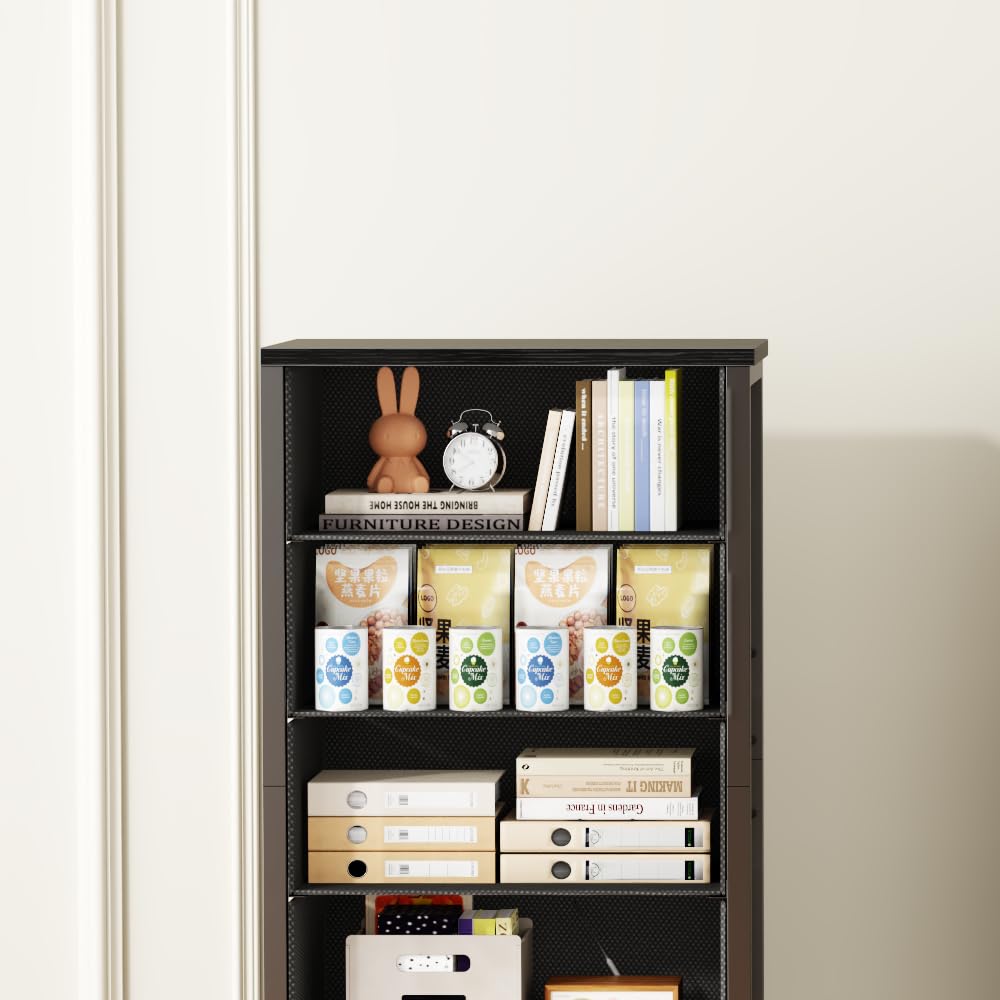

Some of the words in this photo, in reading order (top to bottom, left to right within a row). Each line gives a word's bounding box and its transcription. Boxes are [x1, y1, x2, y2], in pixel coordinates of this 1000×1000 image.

[611, 452, 617, 460] of
[369, 501, 392, 510] HOME
[394, 501, 420, 510] HOUSE
[422, 501, 438, 510] THE
[440, 501, 478, 510] BRINGING
[322, 519, 440, 531] FURNITURE
[447, 519, 521, 531] DESIGN
[326, 666, 352, 674] Cupcake
[394, 666, 420, 674] Cupcake
[461, 666, 486, 674] Cupcake
[528, 666, 554, 674] Cupcake
[596, 666, 621, 674] Cupcake
[663, 666, 688, 674] Cupcake
[333, 674, 348, 682] Mix
[401, 674, 416, 682] Mix
[468, 674, 483, 682] Mix
[535, 674, 550, 682] Mix
[603, 674, 618, 682] Mix
[670, 674, 685, 682] Mix
[626, 780, 638, 792] IT
[640, 780, 683, 792] MAKING
[566, 804, 595, 815] France
[597, 804, 606, 815] in
[608, 804, 644, 815] Gardens
